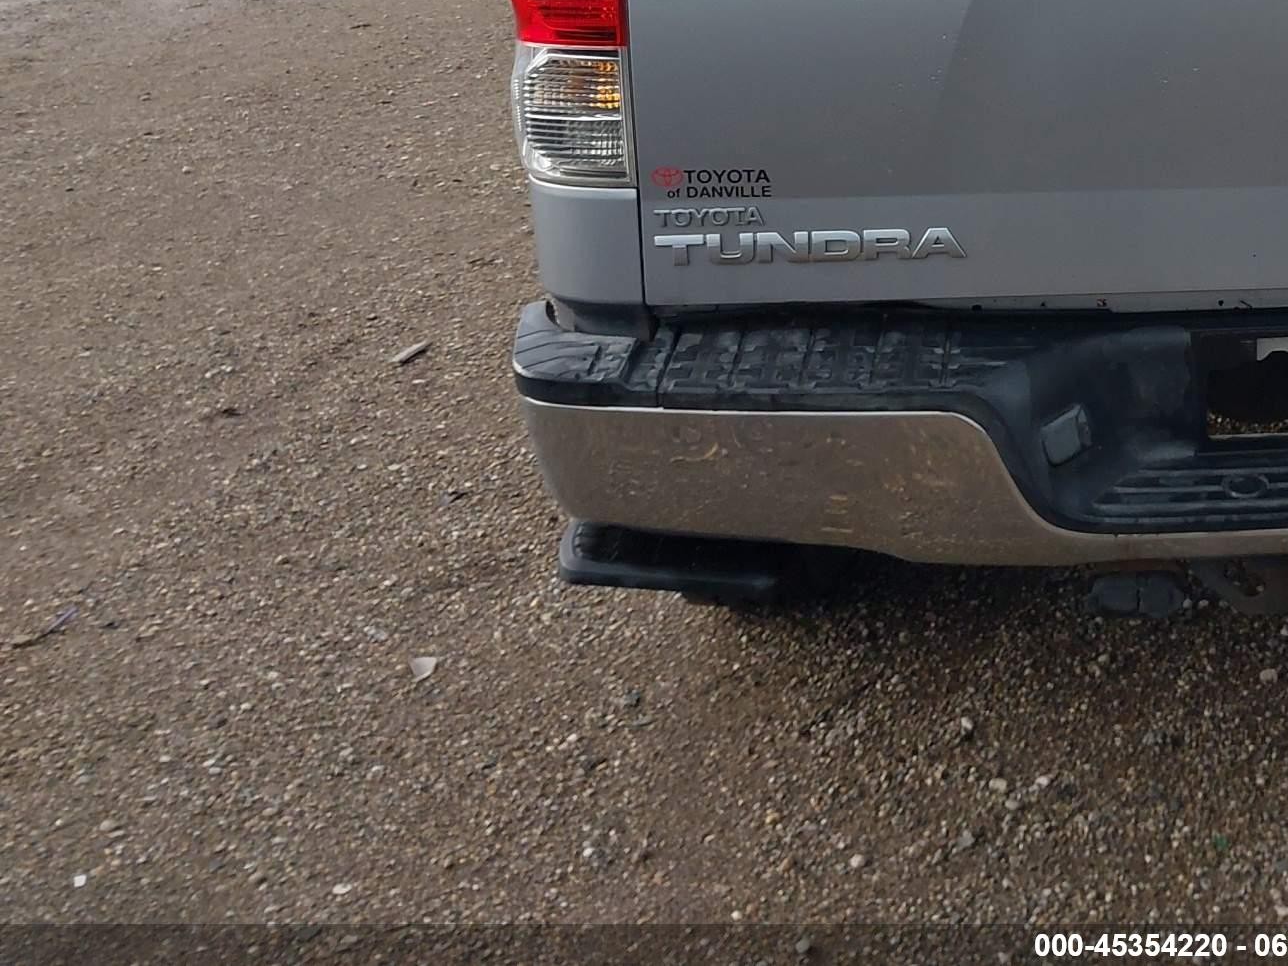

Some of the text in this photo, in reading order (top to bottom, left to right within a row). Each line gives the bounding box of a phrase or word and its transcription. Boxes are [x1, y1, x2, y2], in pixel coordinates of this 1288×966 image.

[683, 169, 771, 184] TOYOTA
[667, 185, 772, 199] of DANVILLE
[653, 206, 766, 228] TOYOTA
[653, 226, 967, 266] TUNDRA
